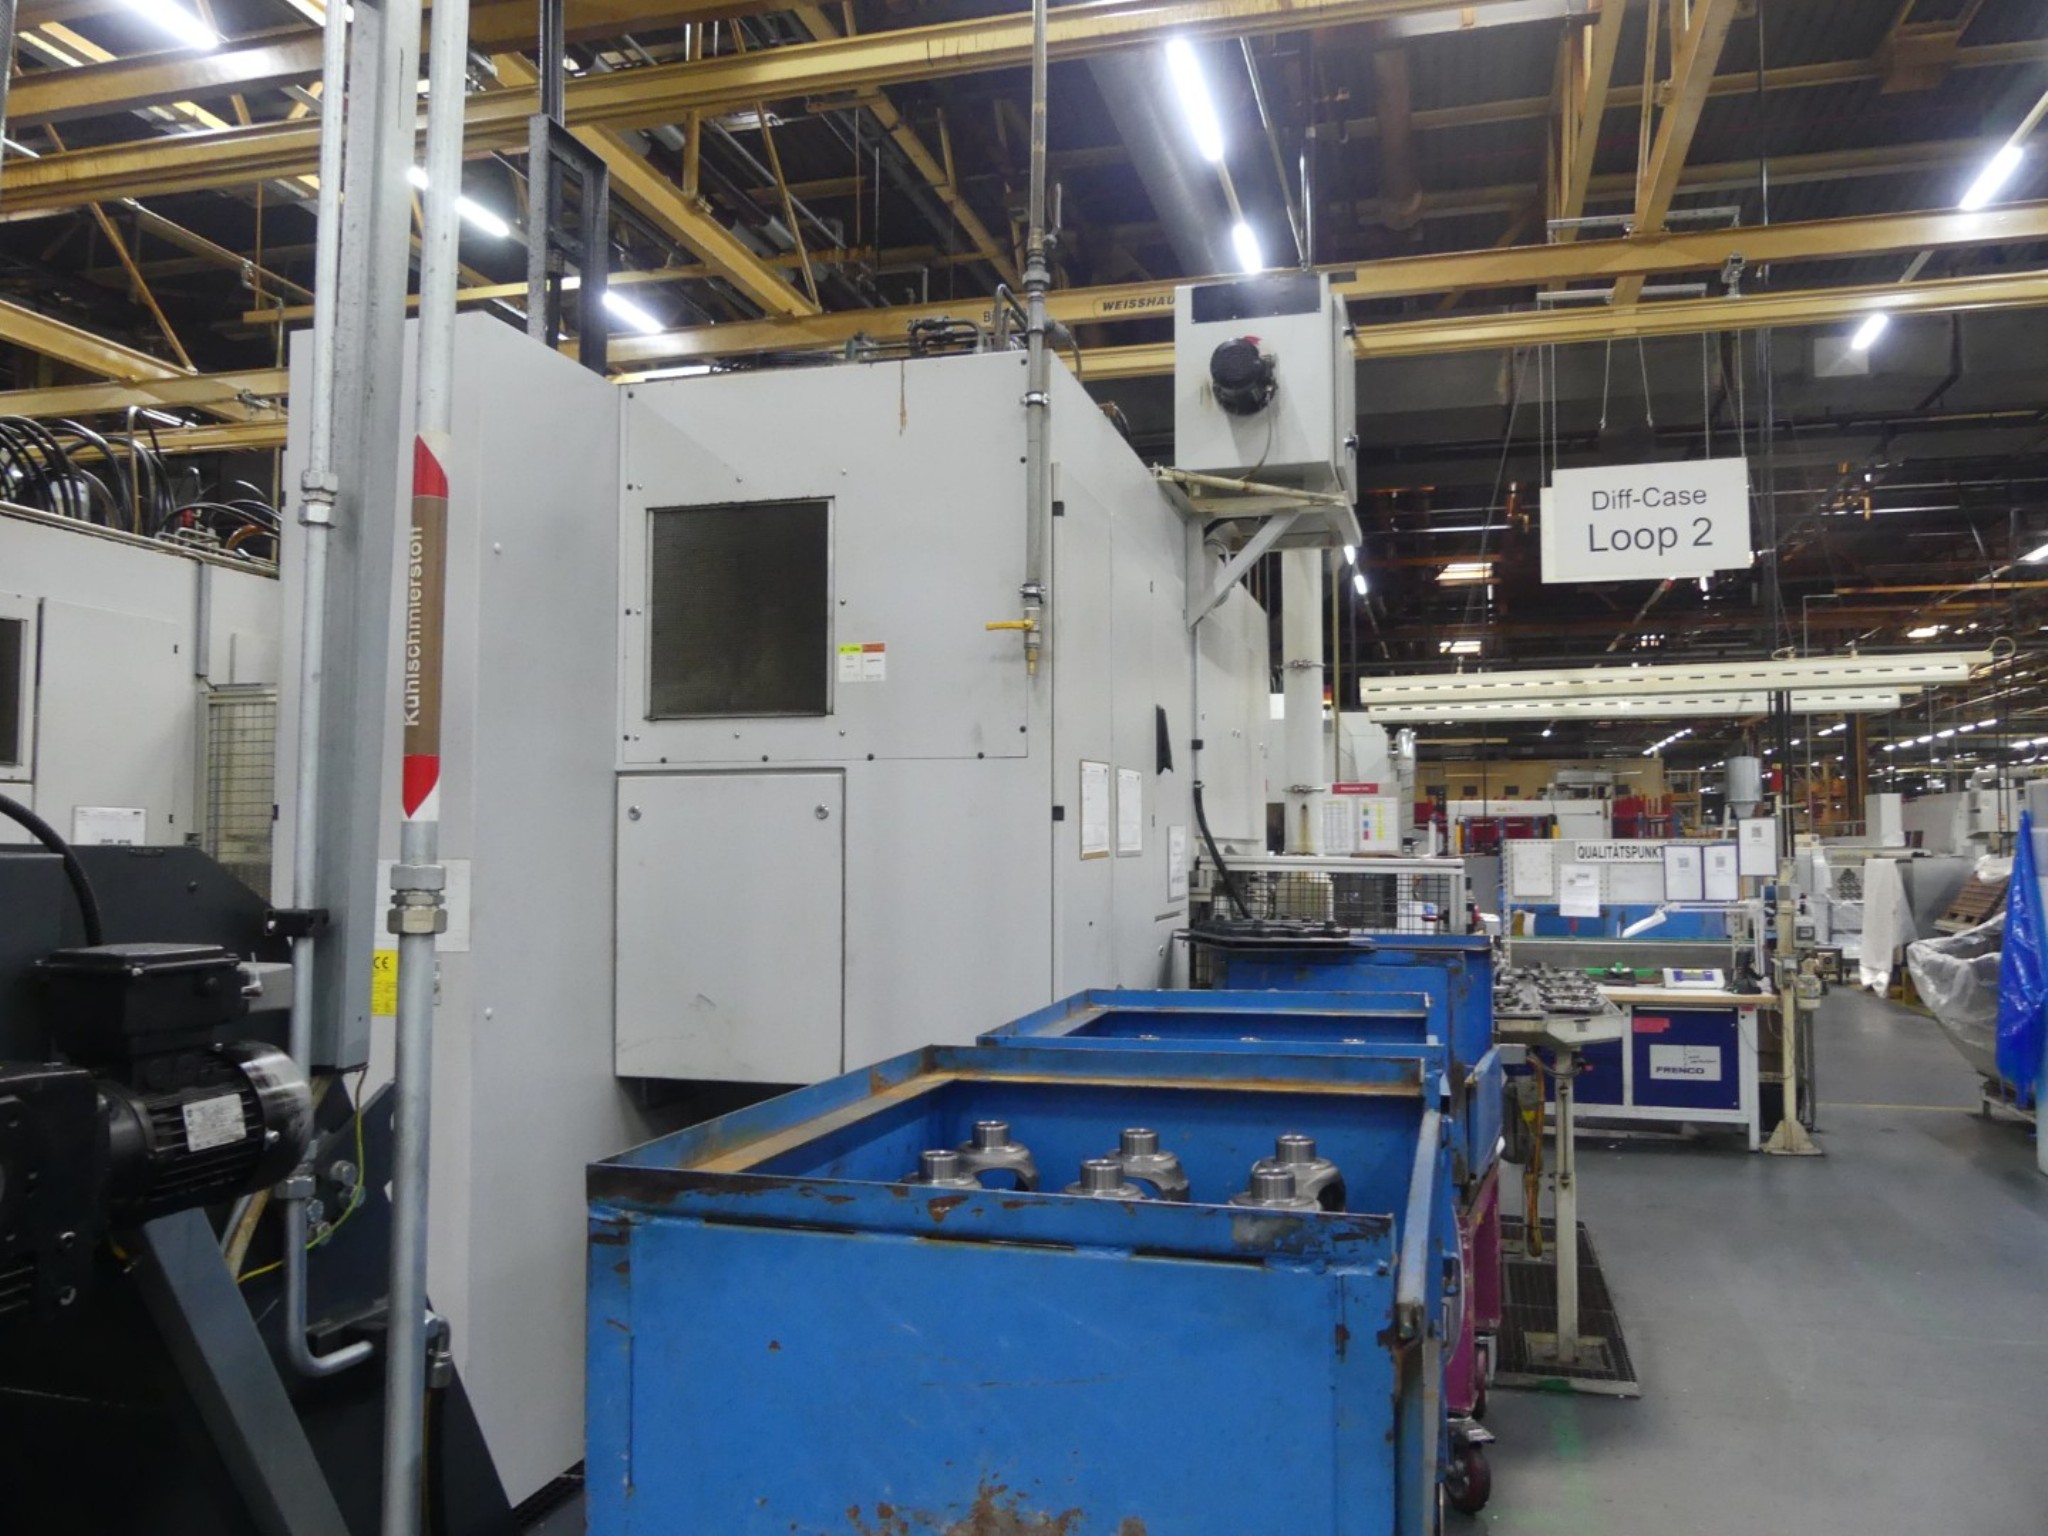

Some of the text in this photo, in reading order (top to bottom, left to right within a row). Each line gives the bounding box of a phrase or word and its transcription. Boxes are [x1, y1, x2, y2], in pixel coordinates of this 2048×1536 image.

[1591, 486, 1707, 511] Diff-Case
[1588, 517, 1713, 556] Loop 2
[1655, 1066, 1705, 1075] FRENCO
